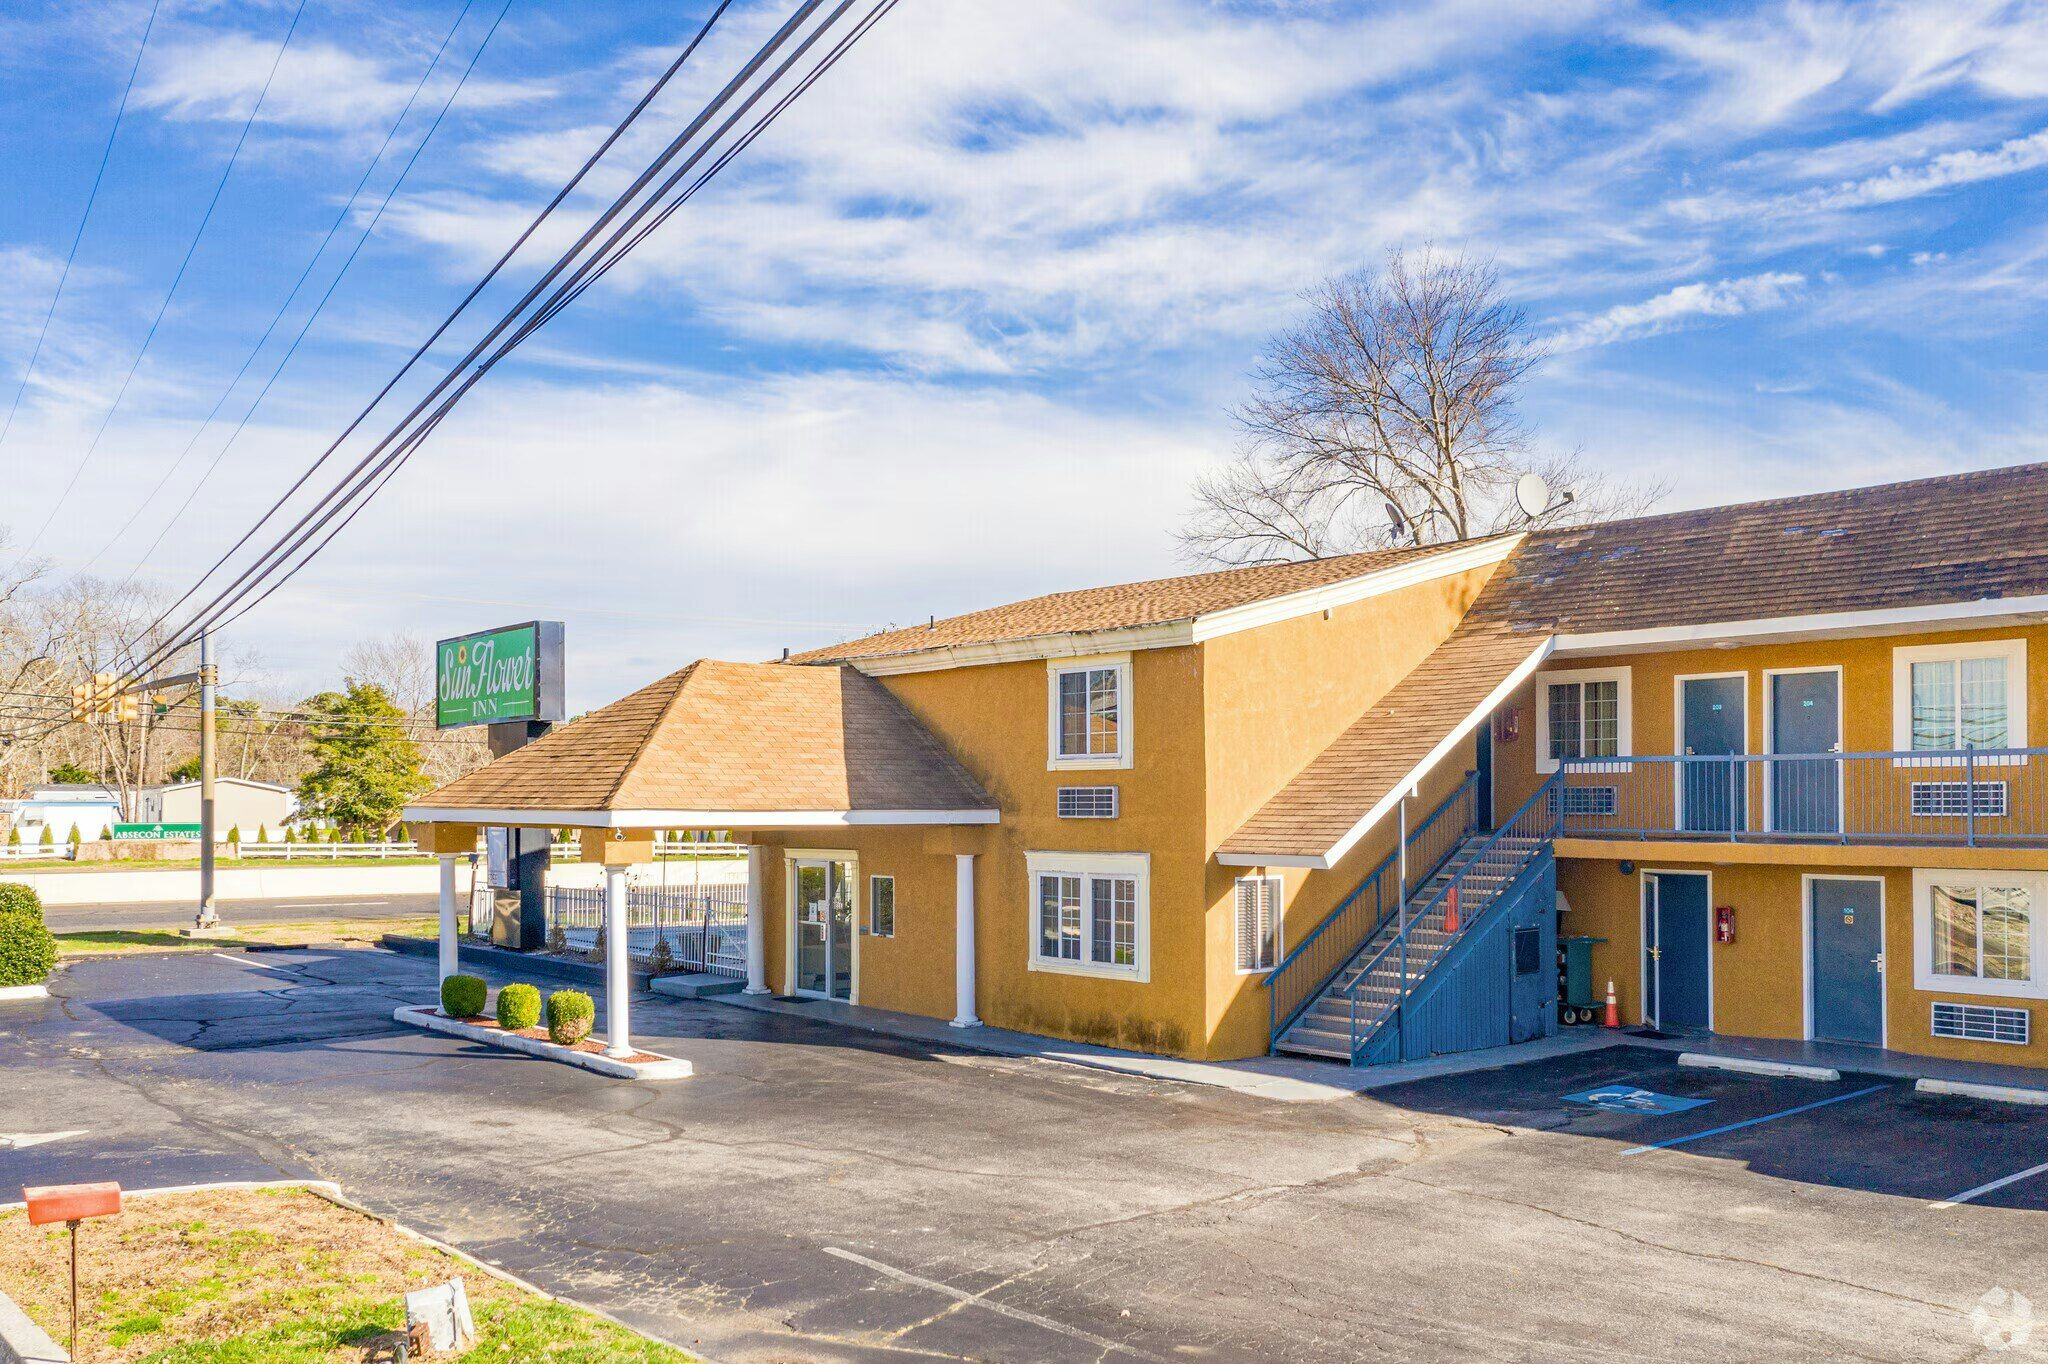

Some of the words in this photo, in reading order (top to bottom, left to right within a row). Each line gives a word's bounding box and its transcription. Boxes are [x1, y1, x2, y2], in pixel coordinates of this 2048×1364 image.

[472, 698, 498, 717] INN
[115, 830, 160, 839] ABSECON
[163, 830, 201, 839] ESTATES
